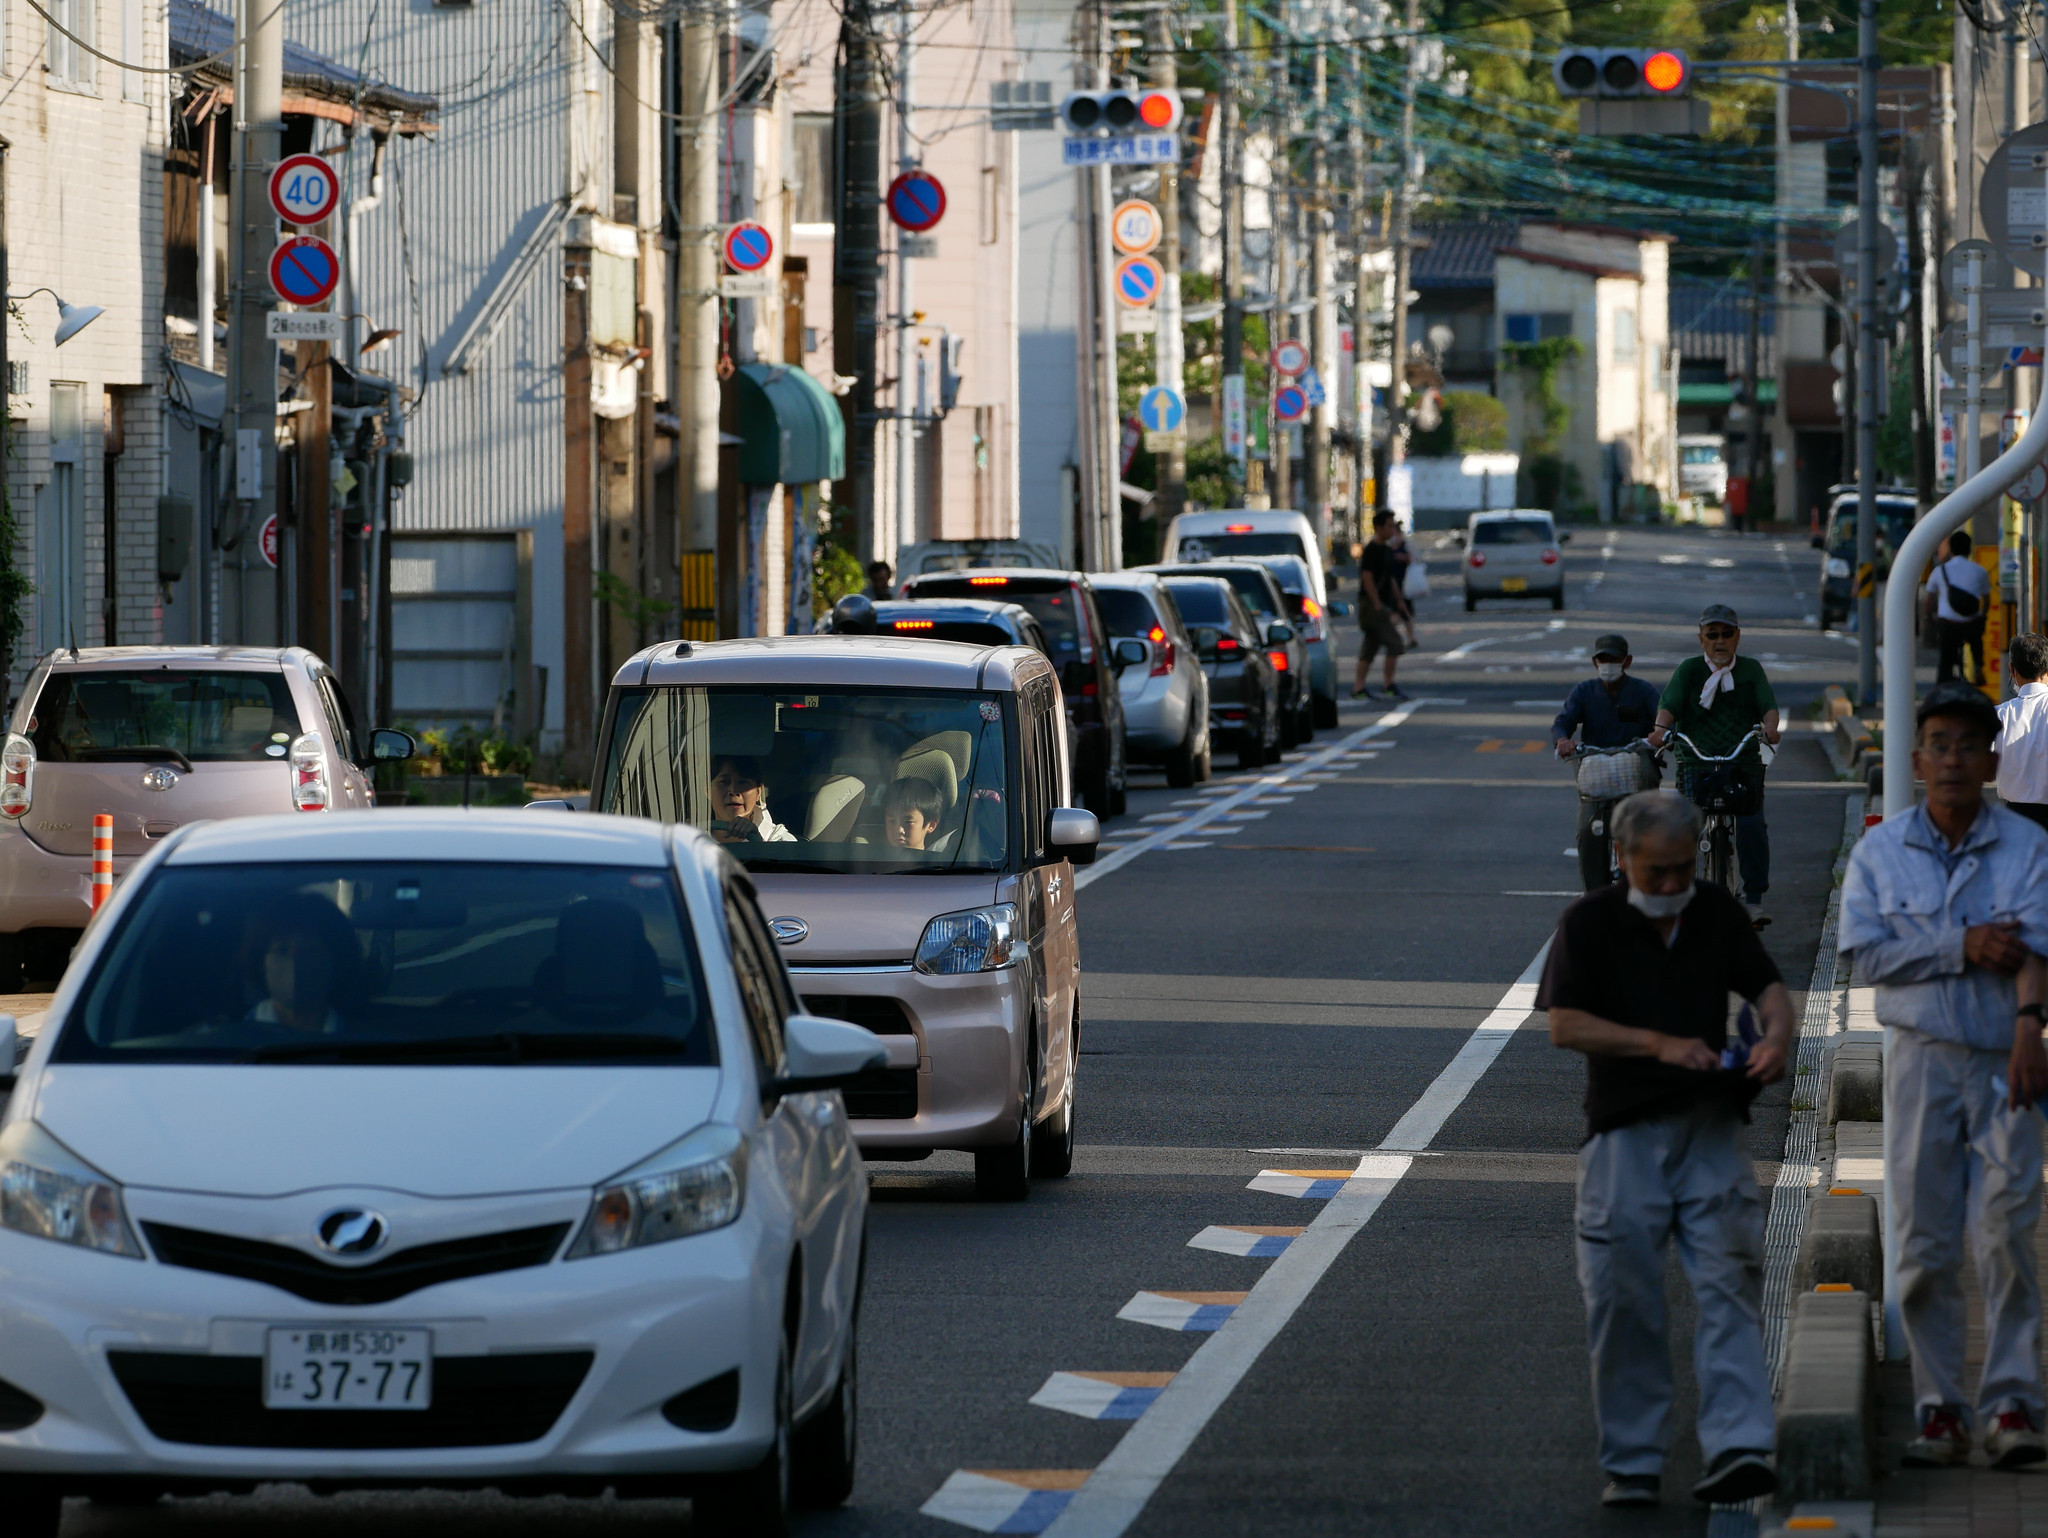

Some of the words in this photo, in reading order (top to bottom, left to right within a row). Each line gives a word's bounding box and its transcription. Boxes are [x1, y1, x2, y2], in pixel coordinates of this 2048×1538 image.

[285, 174, 324, 206] 40
[1123, 216, 1151, 238] 40
[302, 1360, 421, 1401] 37-77
